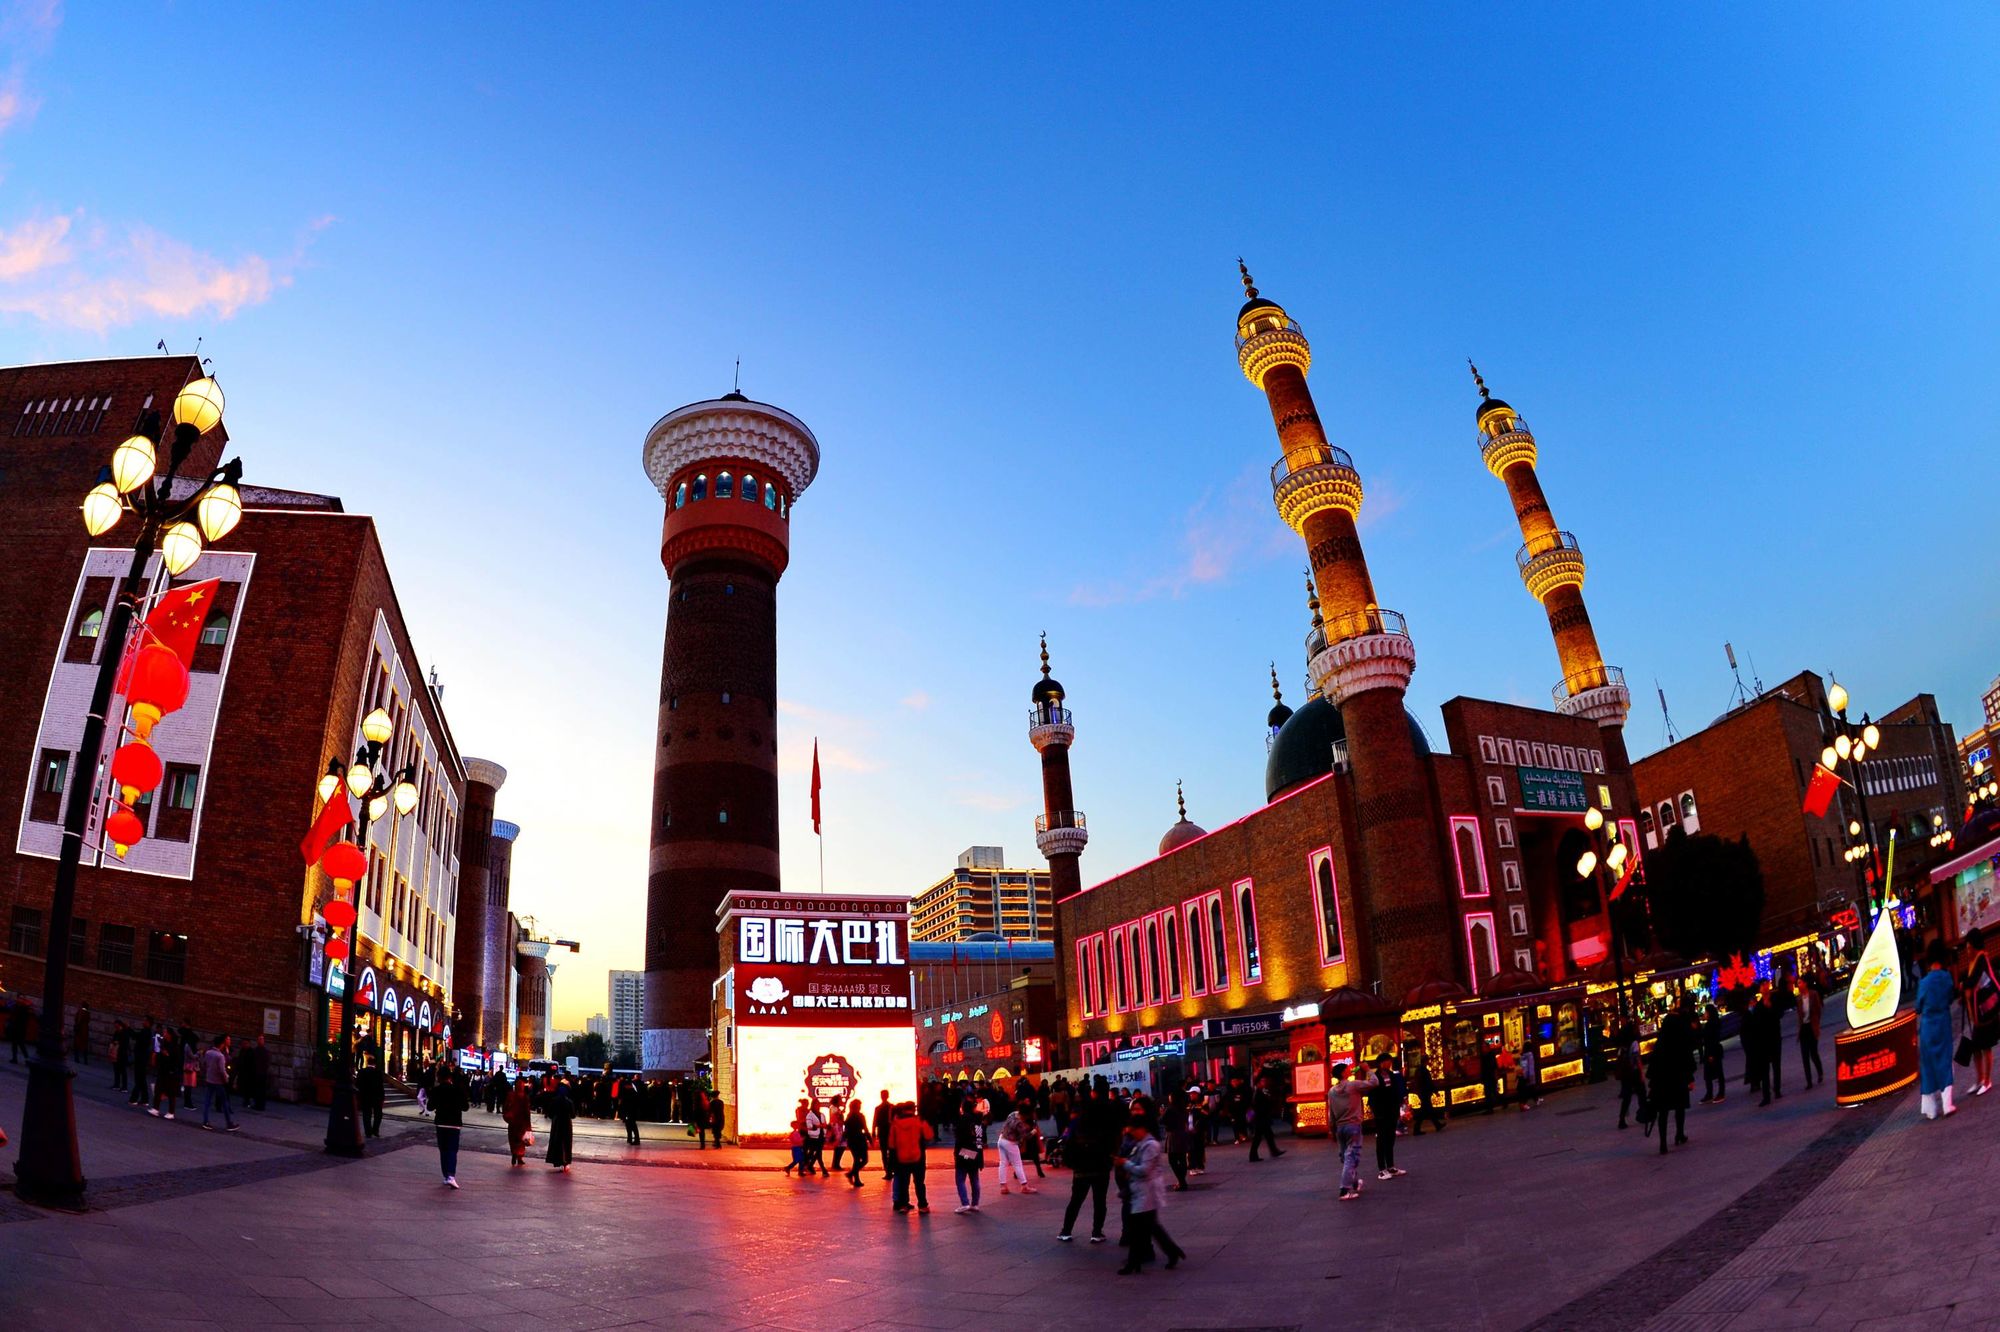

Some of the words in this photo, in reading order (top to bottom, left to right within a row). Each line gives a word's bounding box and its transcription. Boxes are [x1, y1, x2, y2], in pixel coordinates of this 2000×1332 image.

[740, 917, 906, 965] 国际大巴扎
